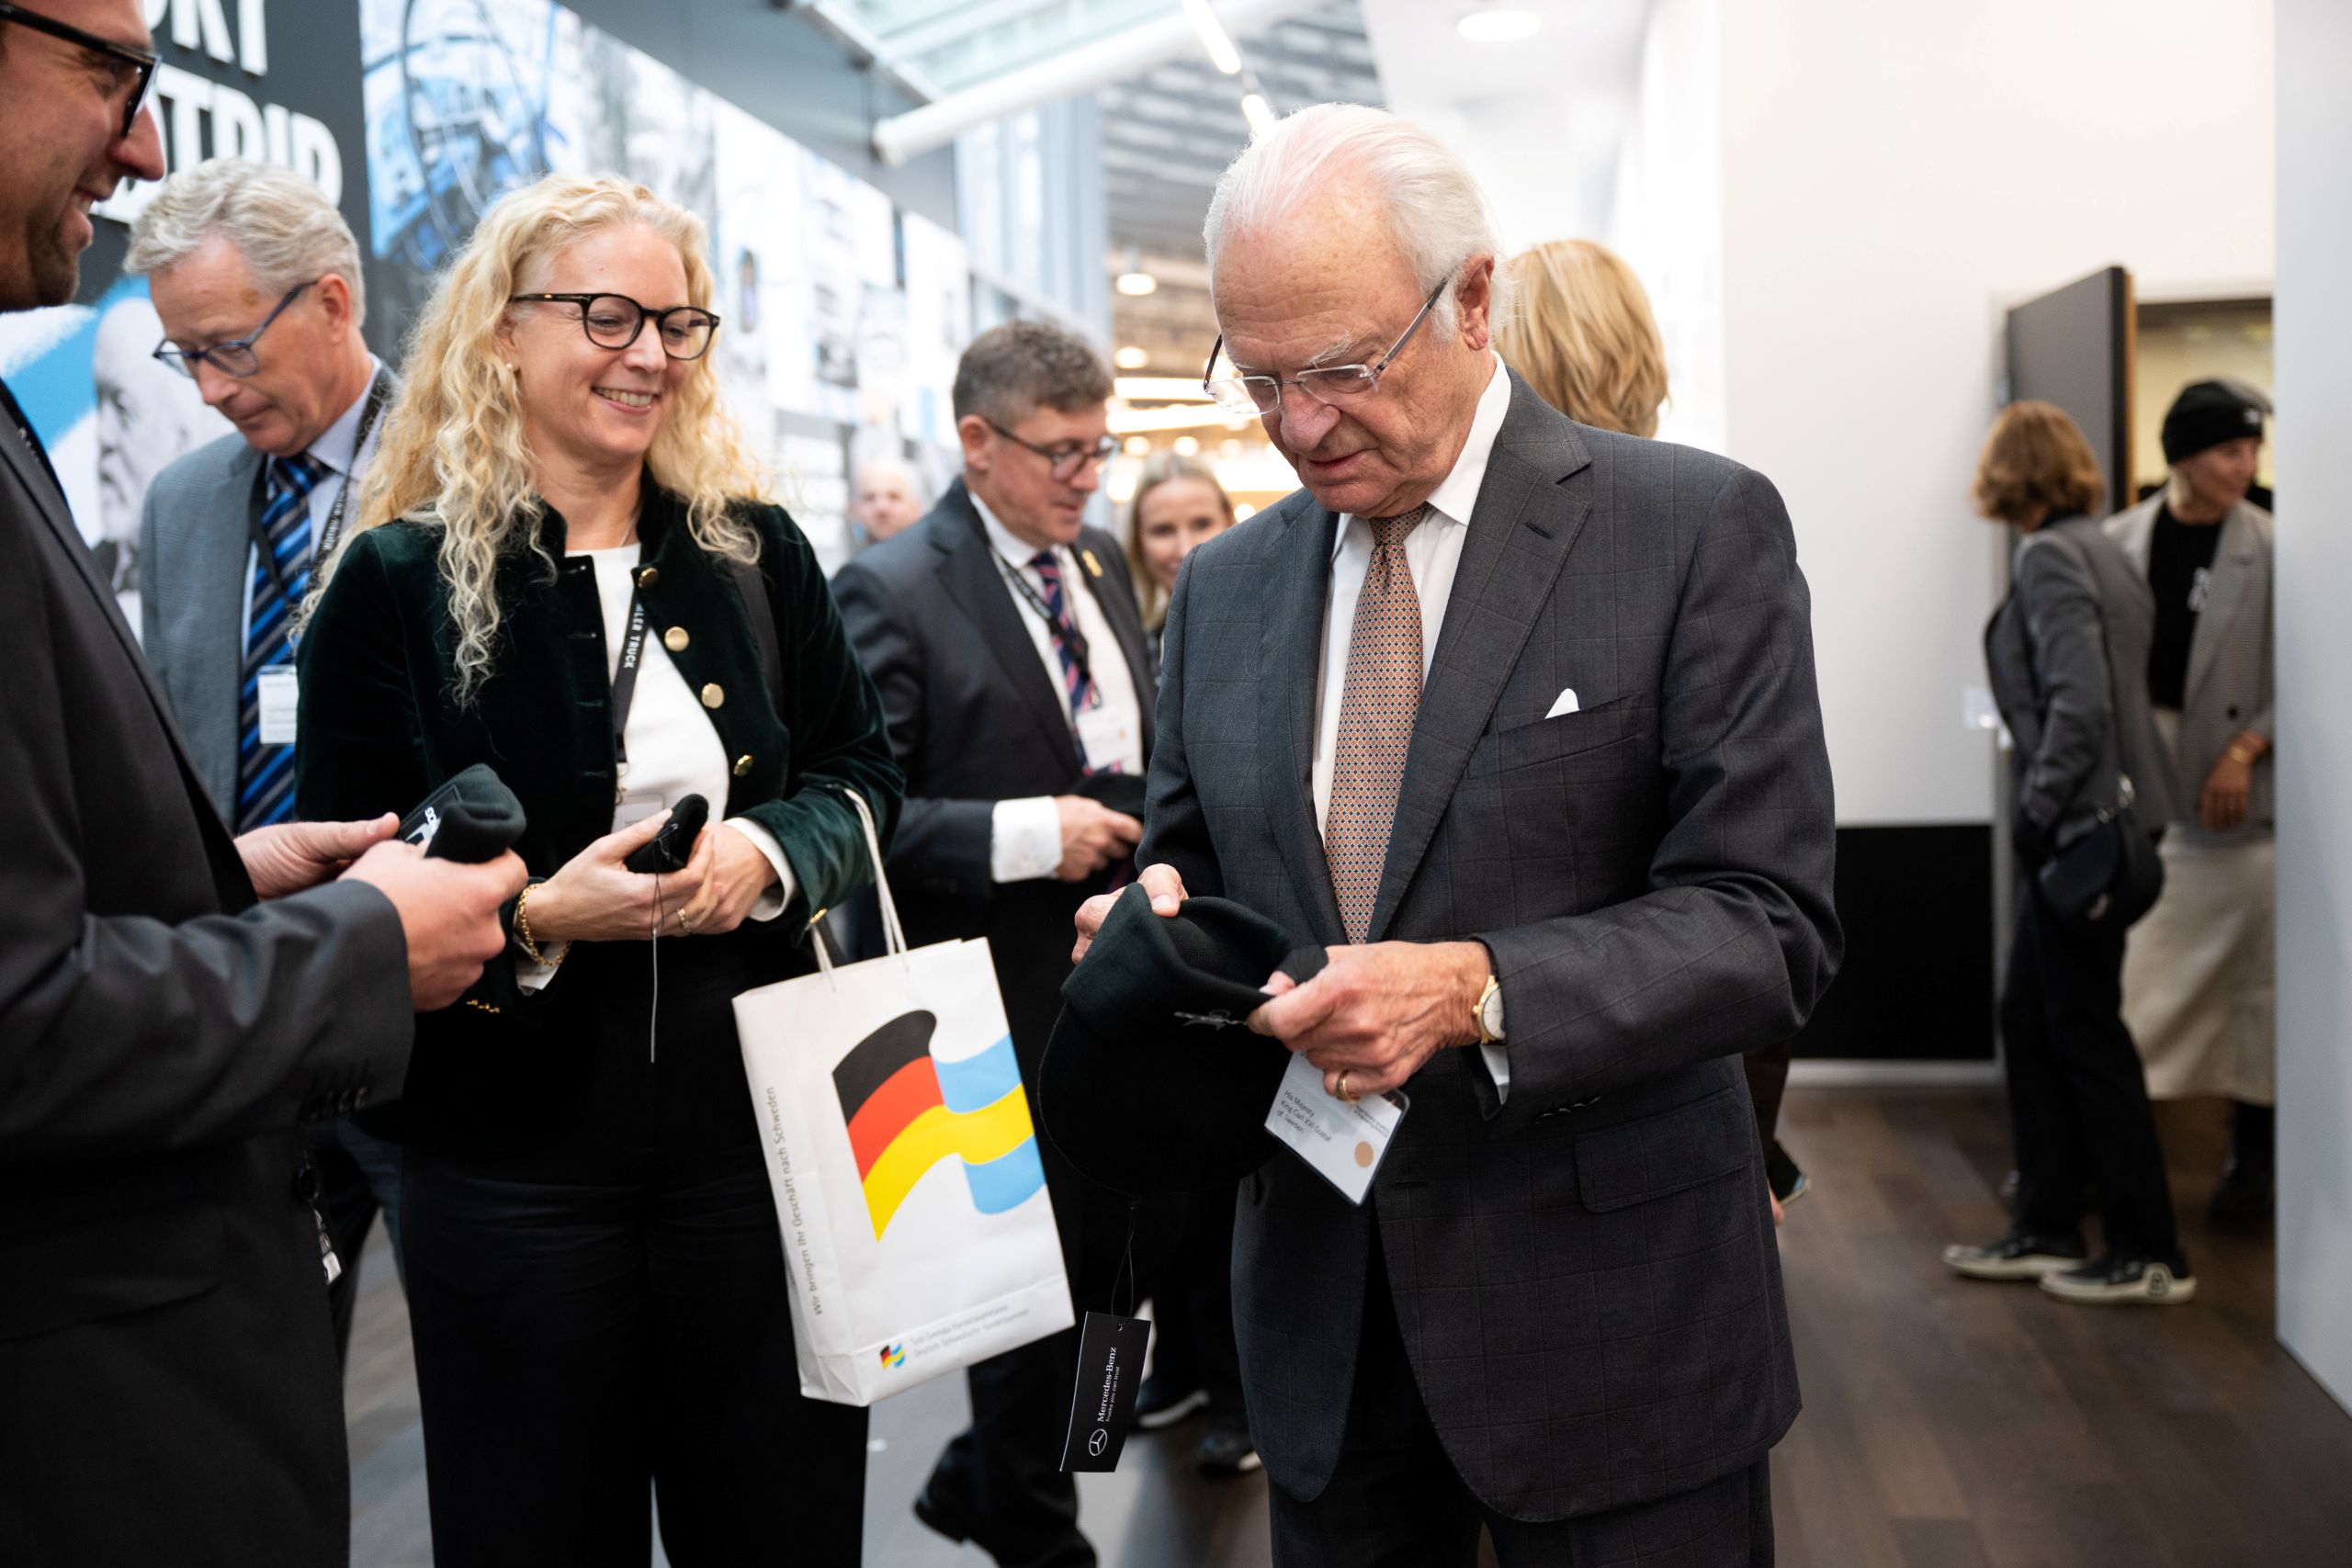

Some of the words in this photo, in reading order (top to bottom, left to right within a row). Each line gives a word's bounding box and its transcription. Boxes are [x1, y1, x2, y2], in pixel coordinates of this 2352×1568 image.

[624, 635, 641, 669] TRUCK
[765, 1087, 786, 1145] Schweden
[779, 1146, 793, 1174] nach
[784, 1177, 803, 1227] Geschäft
[797, 1231, 808, 1247] Ihr
[801, 1249, 817, 1292] bringen
[811, 1295, 822, 1315] Wir
[1097, 1347, 1117, 1423] Mercedes-Benz
[1105, 1404, 1114, 1422] Trucks
